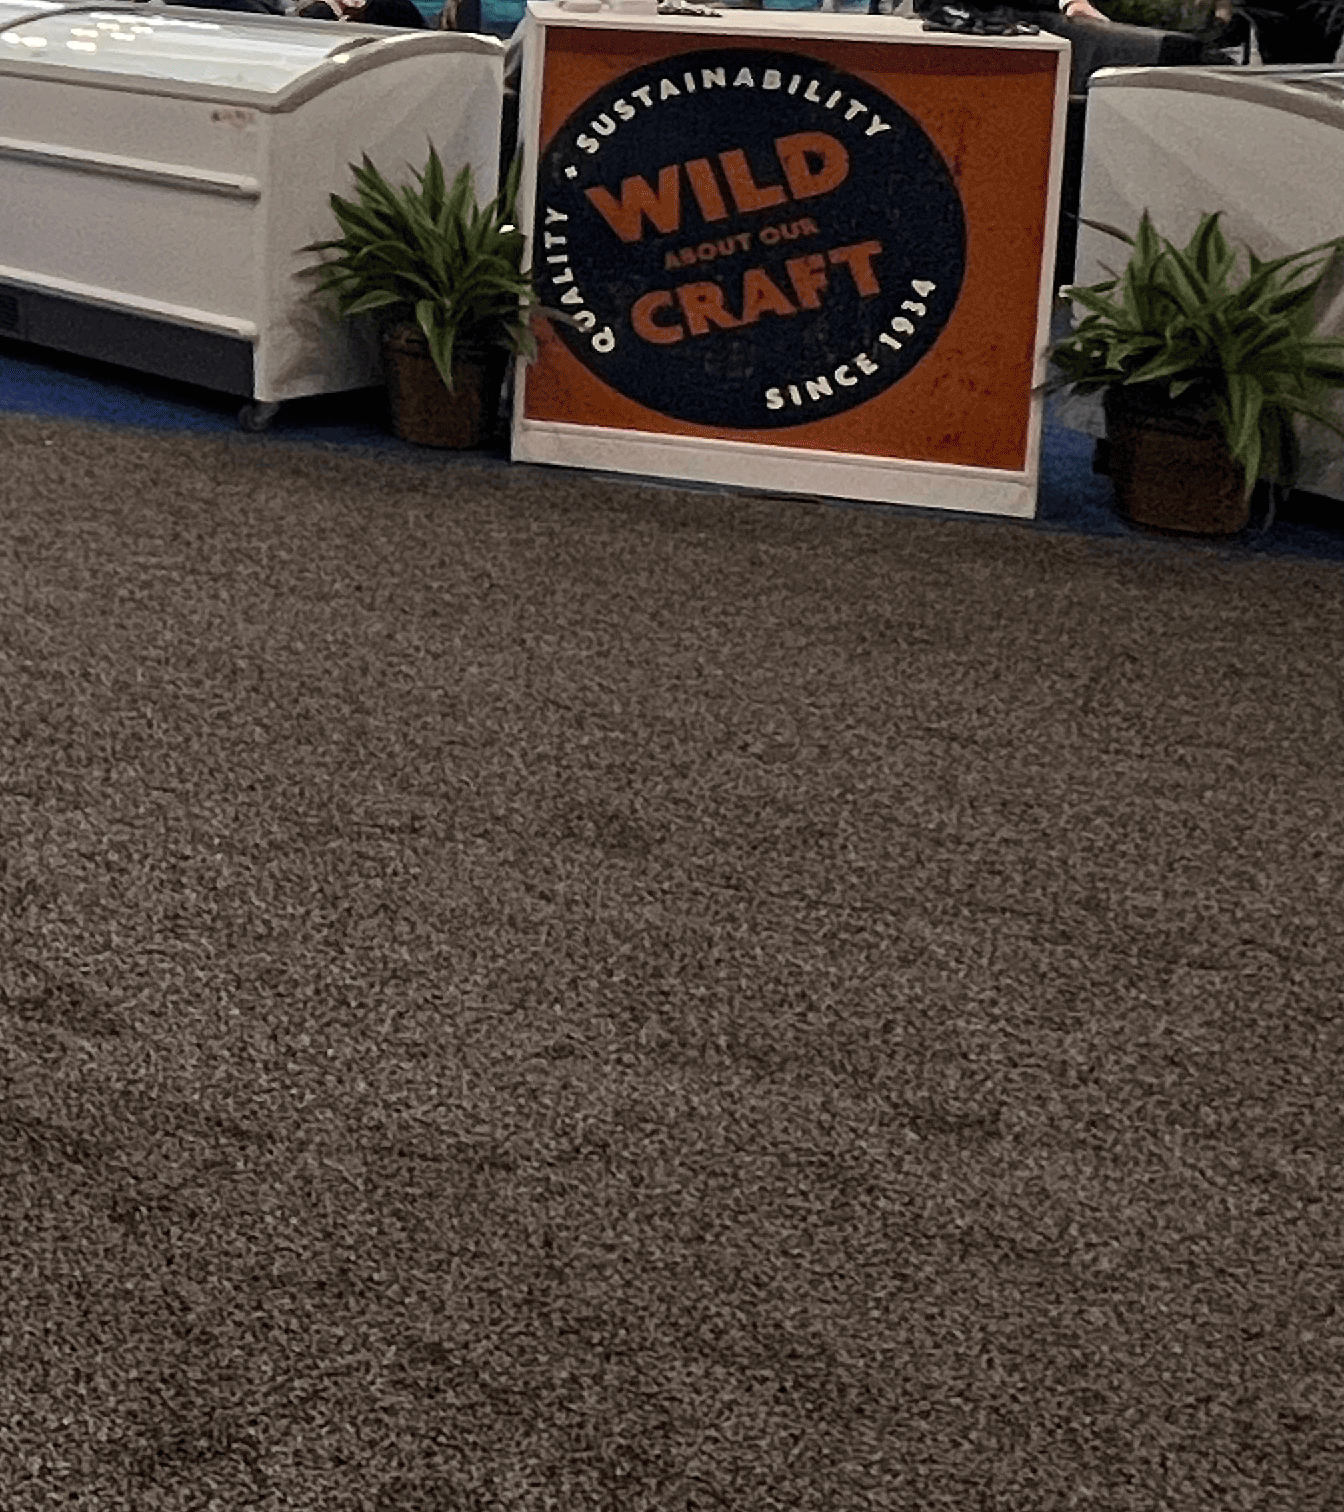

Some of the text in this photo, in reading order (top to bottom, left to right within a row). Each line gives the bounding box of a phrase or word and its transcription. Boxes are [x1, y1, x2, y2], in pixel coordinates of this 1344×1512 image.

[576, 67, 892, 155] SUSTAINABILITY
[583, 130, 850, 244] WILD
[545, 207, 615, 354] QUALITY
[630, 240, 883, 345] CRAFT
[665, 218, 819, 269] ABOUT OUR
[765, 279, 936, 410] SINCE 1934
